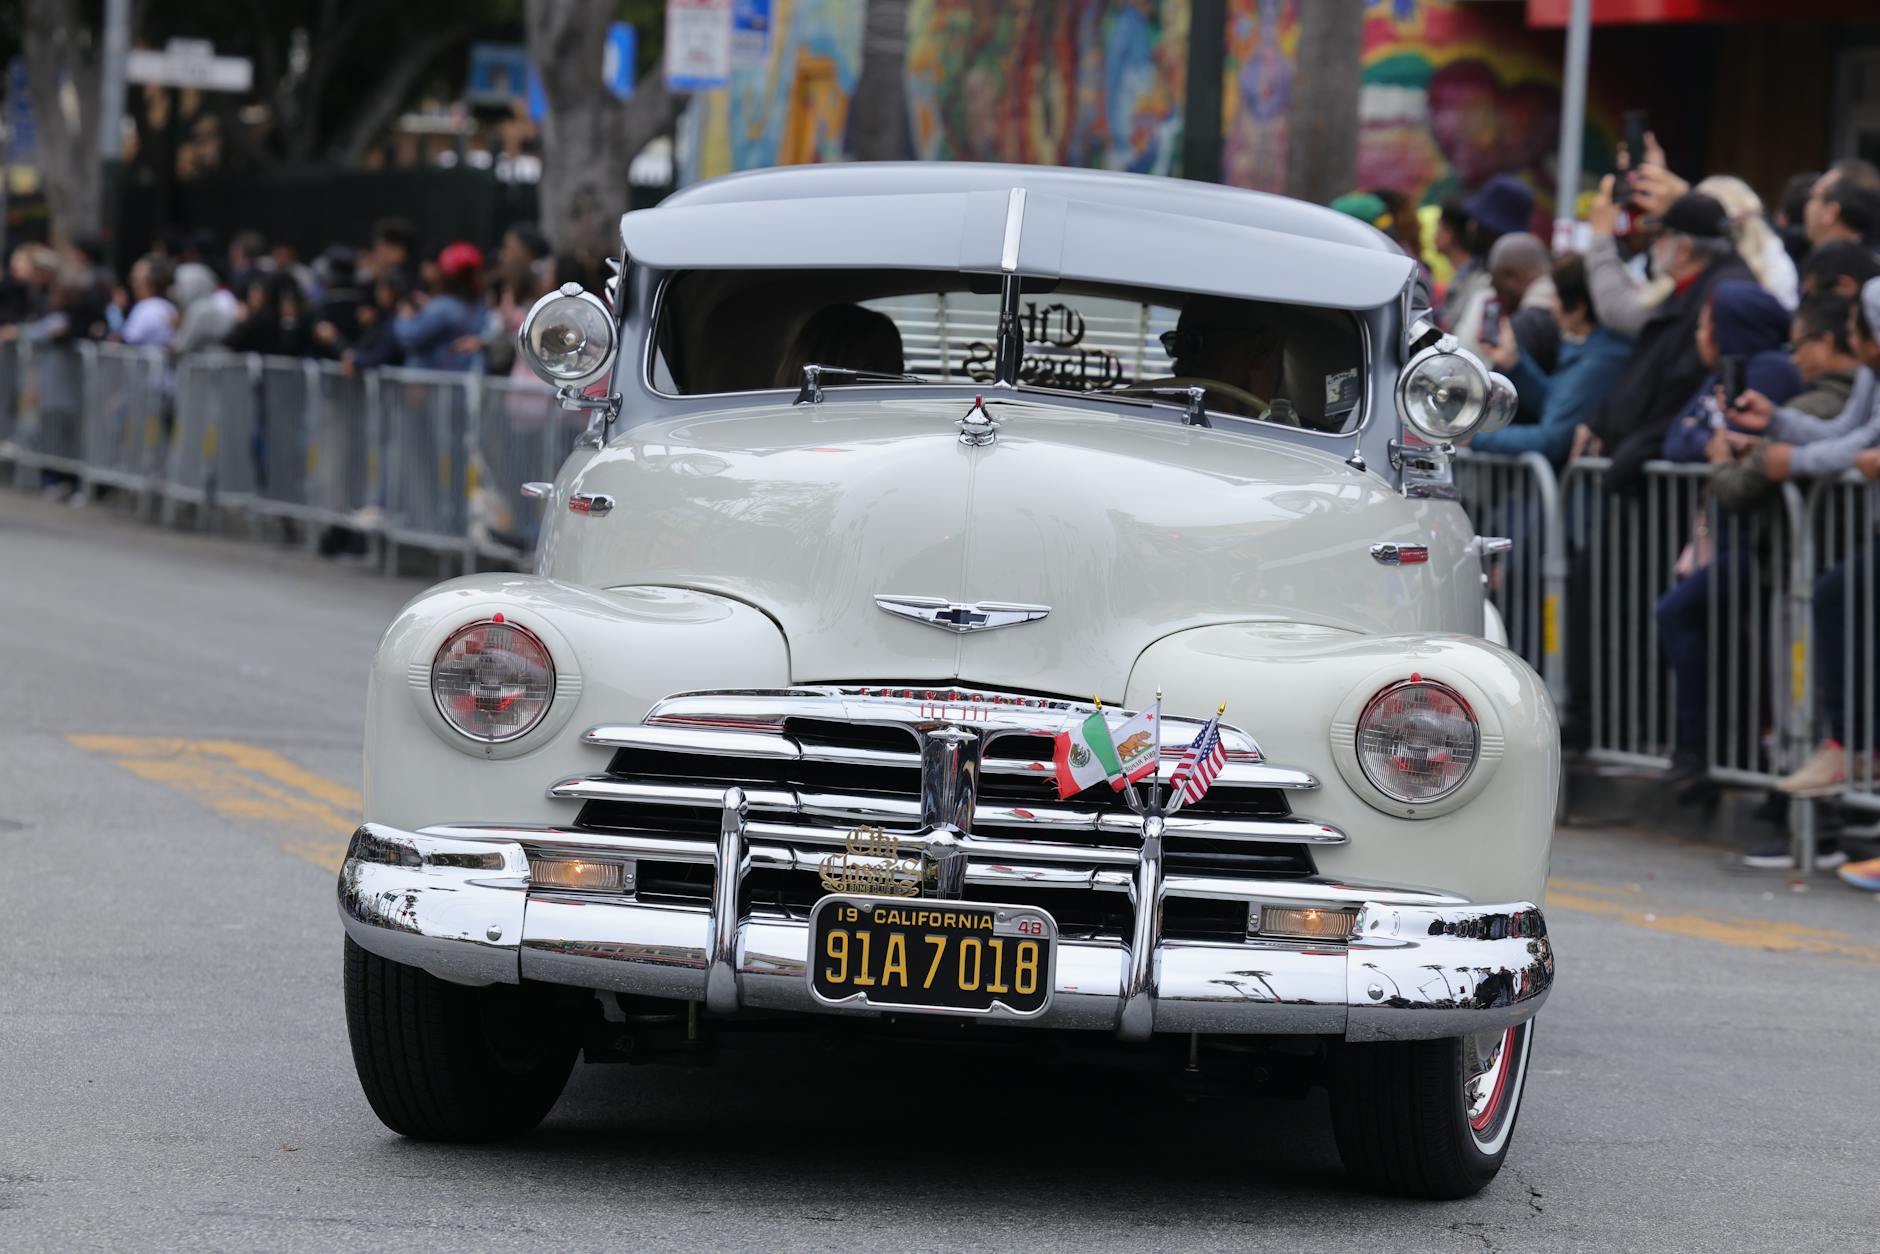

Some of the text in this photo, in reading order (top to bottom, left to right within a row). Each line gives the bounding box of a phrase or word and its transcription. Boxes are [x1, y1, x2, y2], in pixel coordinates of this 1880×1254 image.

[860, 687, 1048, 708] CHEVROLET
[845, 824, 899, 857] City
[837, 907, 1042, 934] 19 CALIFORNIA 48
